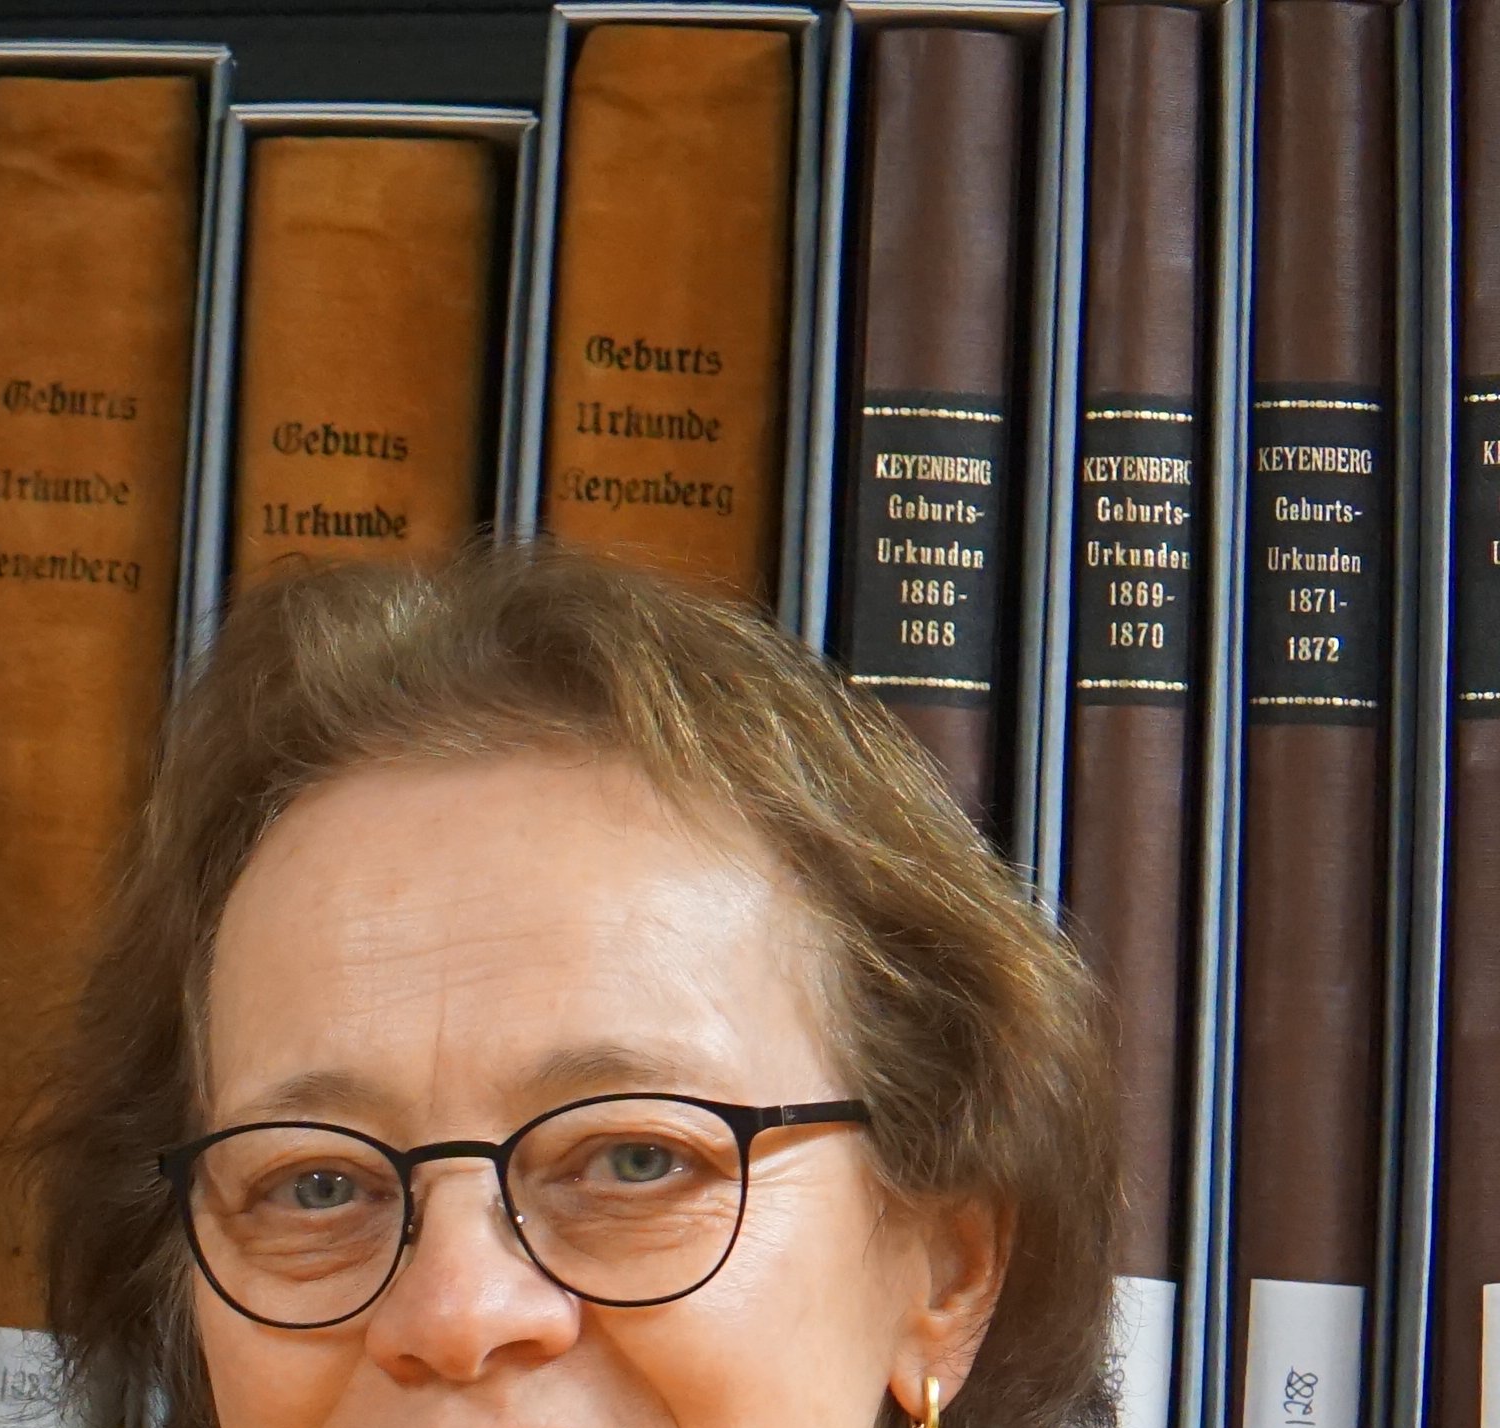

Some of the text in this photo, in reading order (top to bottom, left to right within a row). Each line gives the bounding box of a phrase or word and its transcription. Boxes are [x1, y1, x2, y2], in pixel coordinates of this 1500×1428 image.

[586, 335, 723, 375] Geburts
[577, 401, 721, 442] Urkunde
[273, 421, 409, 461] Geburts
[876, 454, 992, 486] KEYENBERG
[1258, 446, 1373, 475] KEYENBERG
[264, 503, 407, 539] Urkunde
[889, 493, 985, 524] Geburts-
[1097, 496, 1191, 525] Geburts-
[1275, 496, 1363, 523] Geburts-
[877, 537, 984, 569] Urkunden
[1087, 541, 1191, 570] Urkunden
[1268, 546, 1361, 573] Urkunden
[901, 579, 968, 607] 1866-
[1110, 581, 1176, 608] 1869-
[1290, 588, 1348, 613] 1871-
[901, 618, 955, 646] 1868
[1110, 621, 1164, 648] 1870
[1288, 636, 1339, 662] 1872
